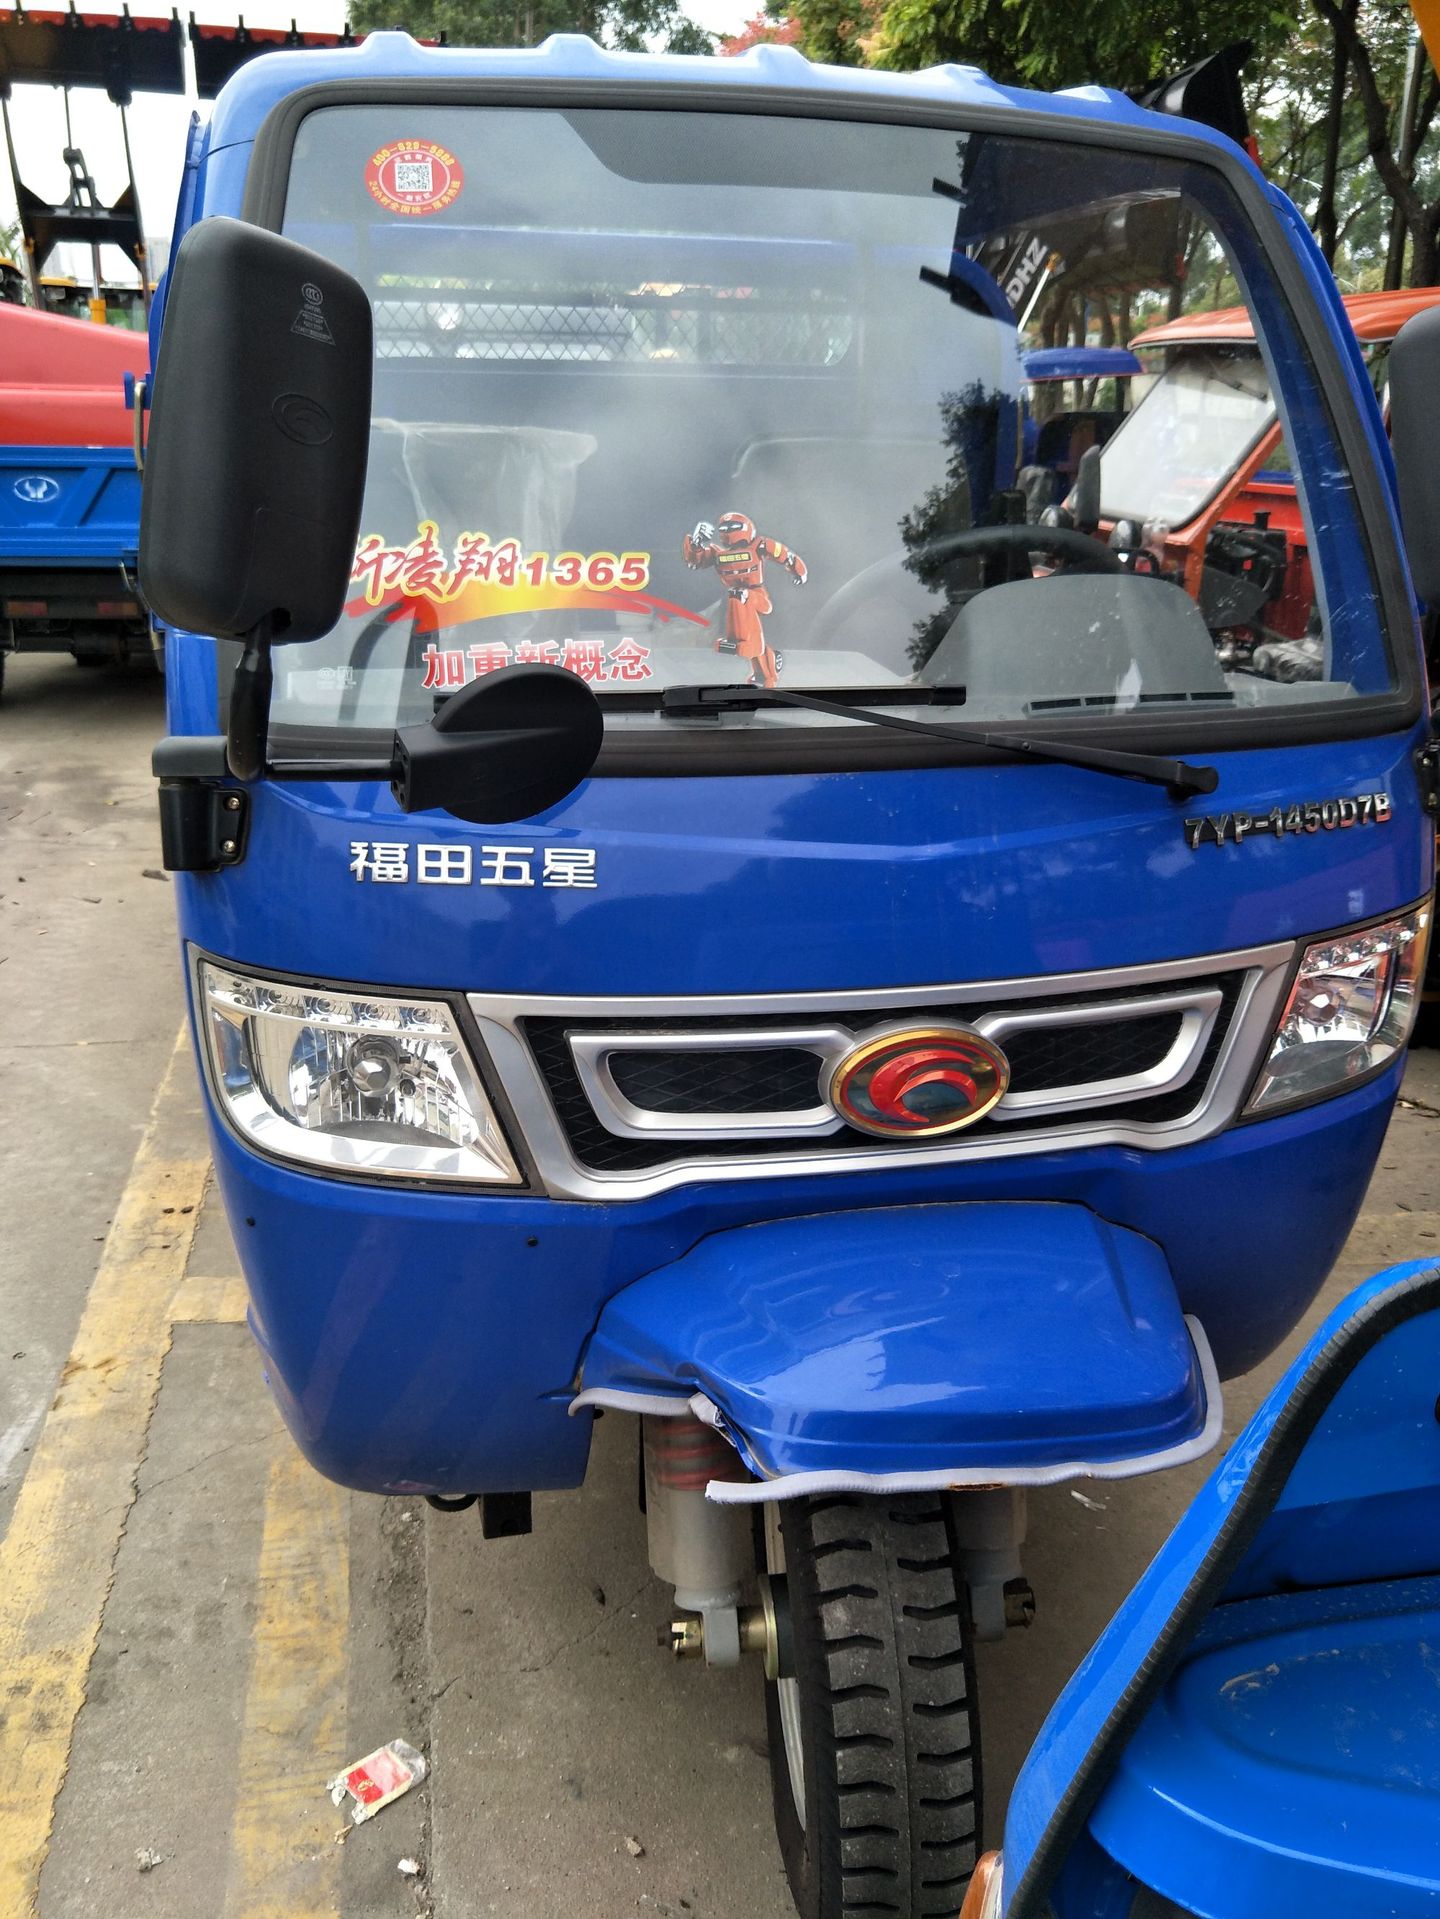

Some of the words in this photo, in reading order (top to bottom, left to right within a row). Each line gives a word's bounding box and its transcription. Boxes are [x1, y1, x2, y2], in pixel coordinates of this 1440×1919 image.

[1184, 793, 1392, 849] 7YP-1450D7B
[350, 841, 598, 888] 福田五星
